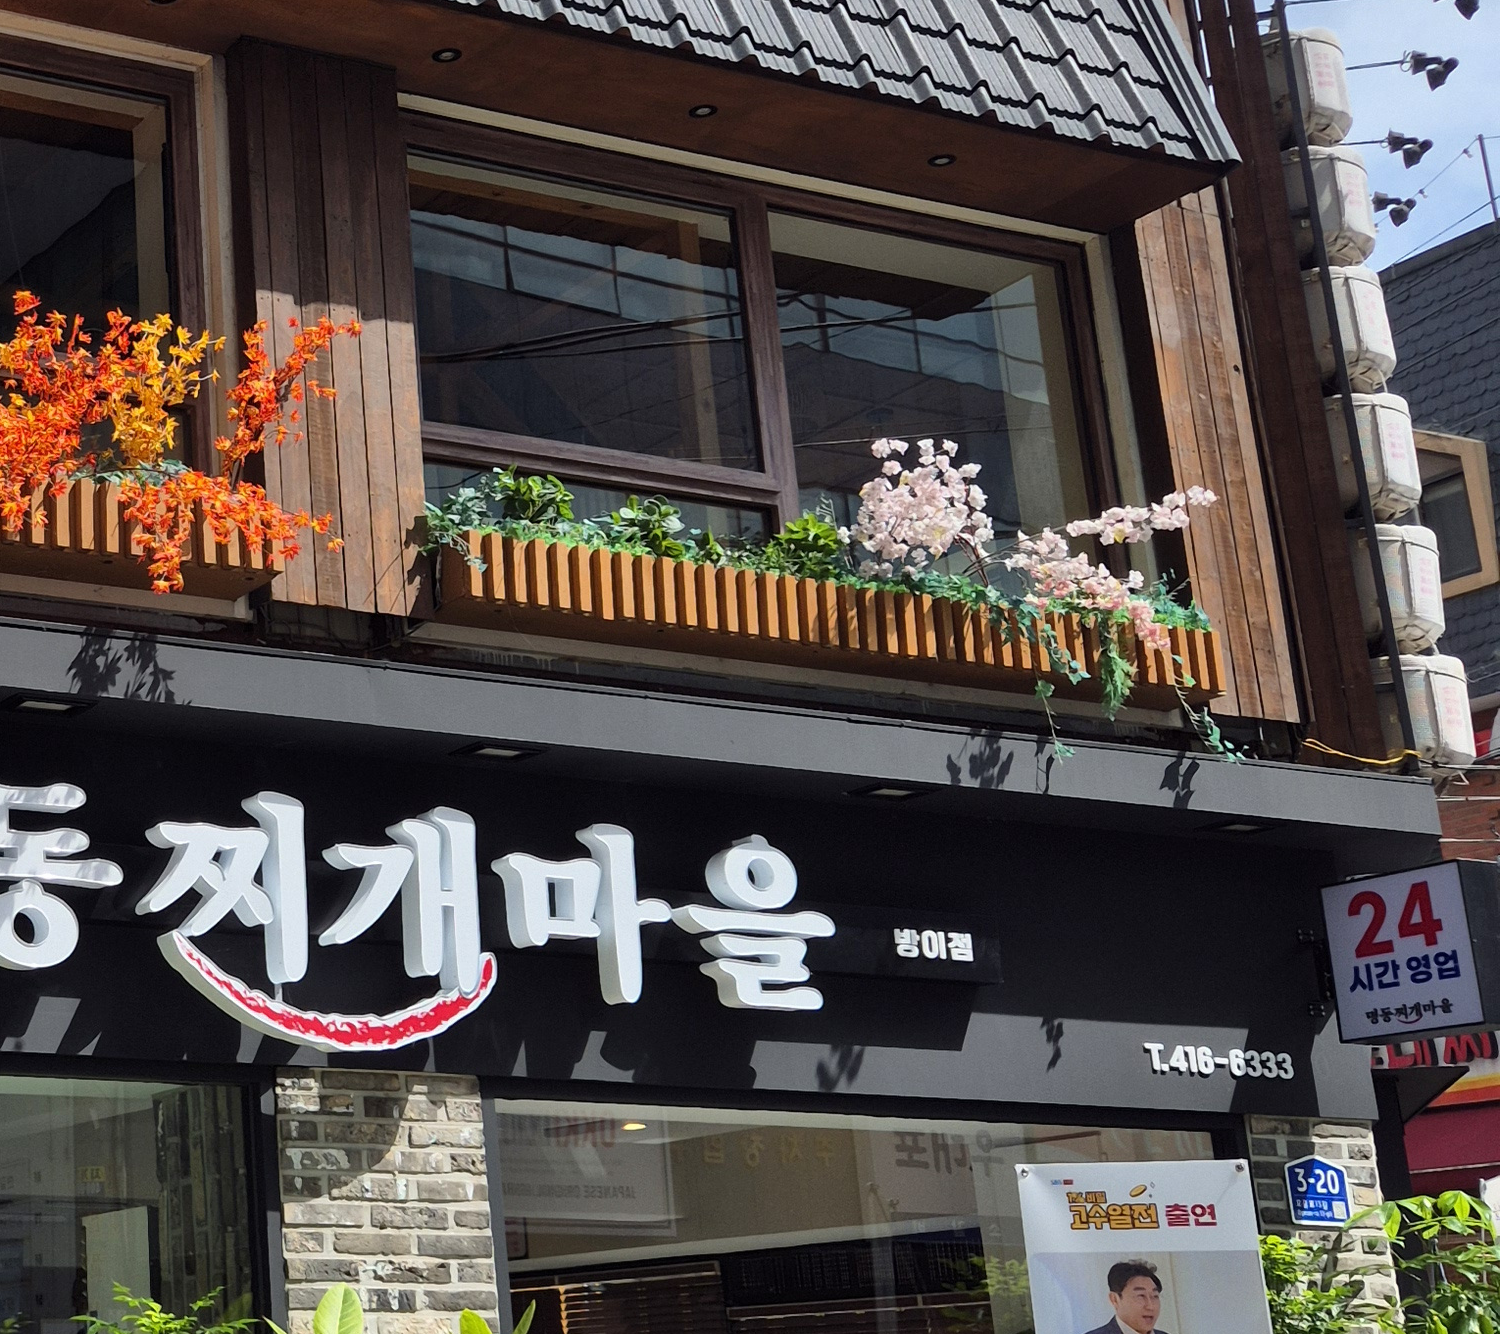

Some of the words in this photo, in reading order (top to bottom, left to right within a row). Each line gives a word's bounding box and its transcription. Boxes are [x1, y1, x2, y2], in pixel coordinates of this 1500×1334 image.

[1347, 880, 1443, 959] 24
[894, 927, 975, 963] 방이점
[1349, 959, 1400, 994] 시간
[1406, 949, 1462, 984] 영업
[1293, 1167, 1340, 1195] 3-20
[1069, 1203, 1160, 1230] 고수열전
[1165, 1203, 1218, 1227] 출연
